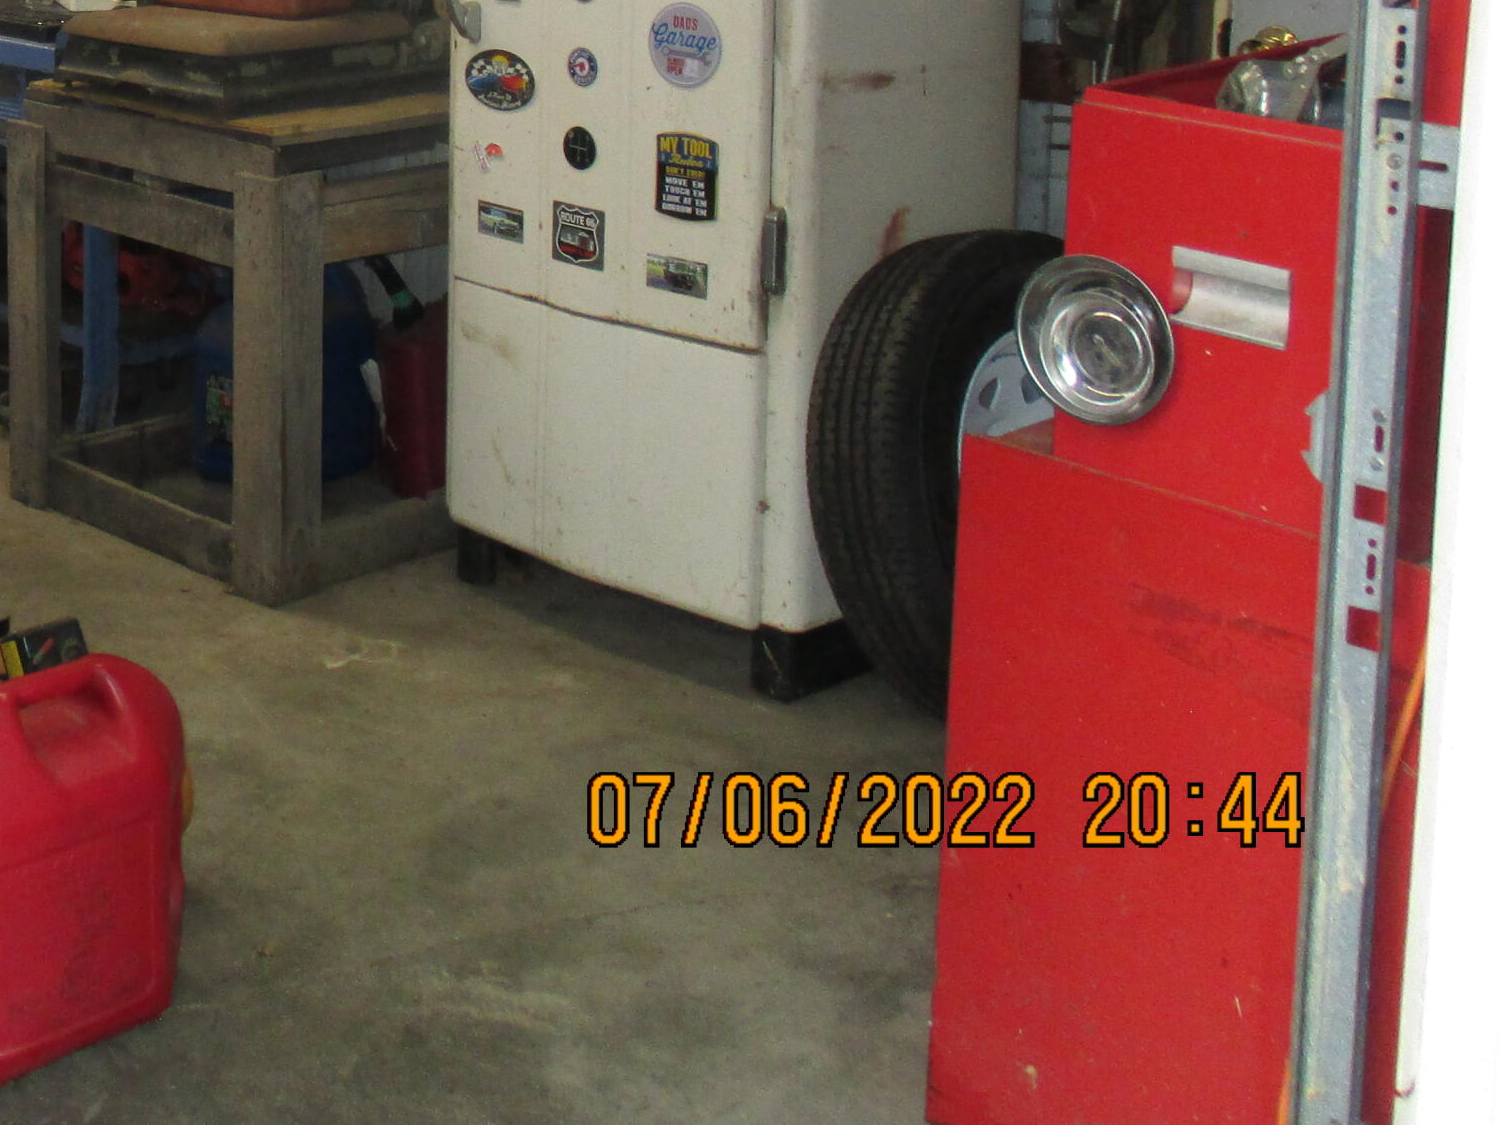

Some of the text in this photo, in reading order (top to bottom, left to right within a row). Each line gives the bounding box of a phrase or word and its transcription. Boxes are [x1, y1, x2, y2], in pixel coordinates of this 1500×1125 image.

[673, 15, 698, 31] DADS
[652, 22, 718, 53] Garage
[660, 136, 713, 160] MY TOOL
[665, 176, 689, 187] MOVE
[560, 211, 585, 225] ROUTE
